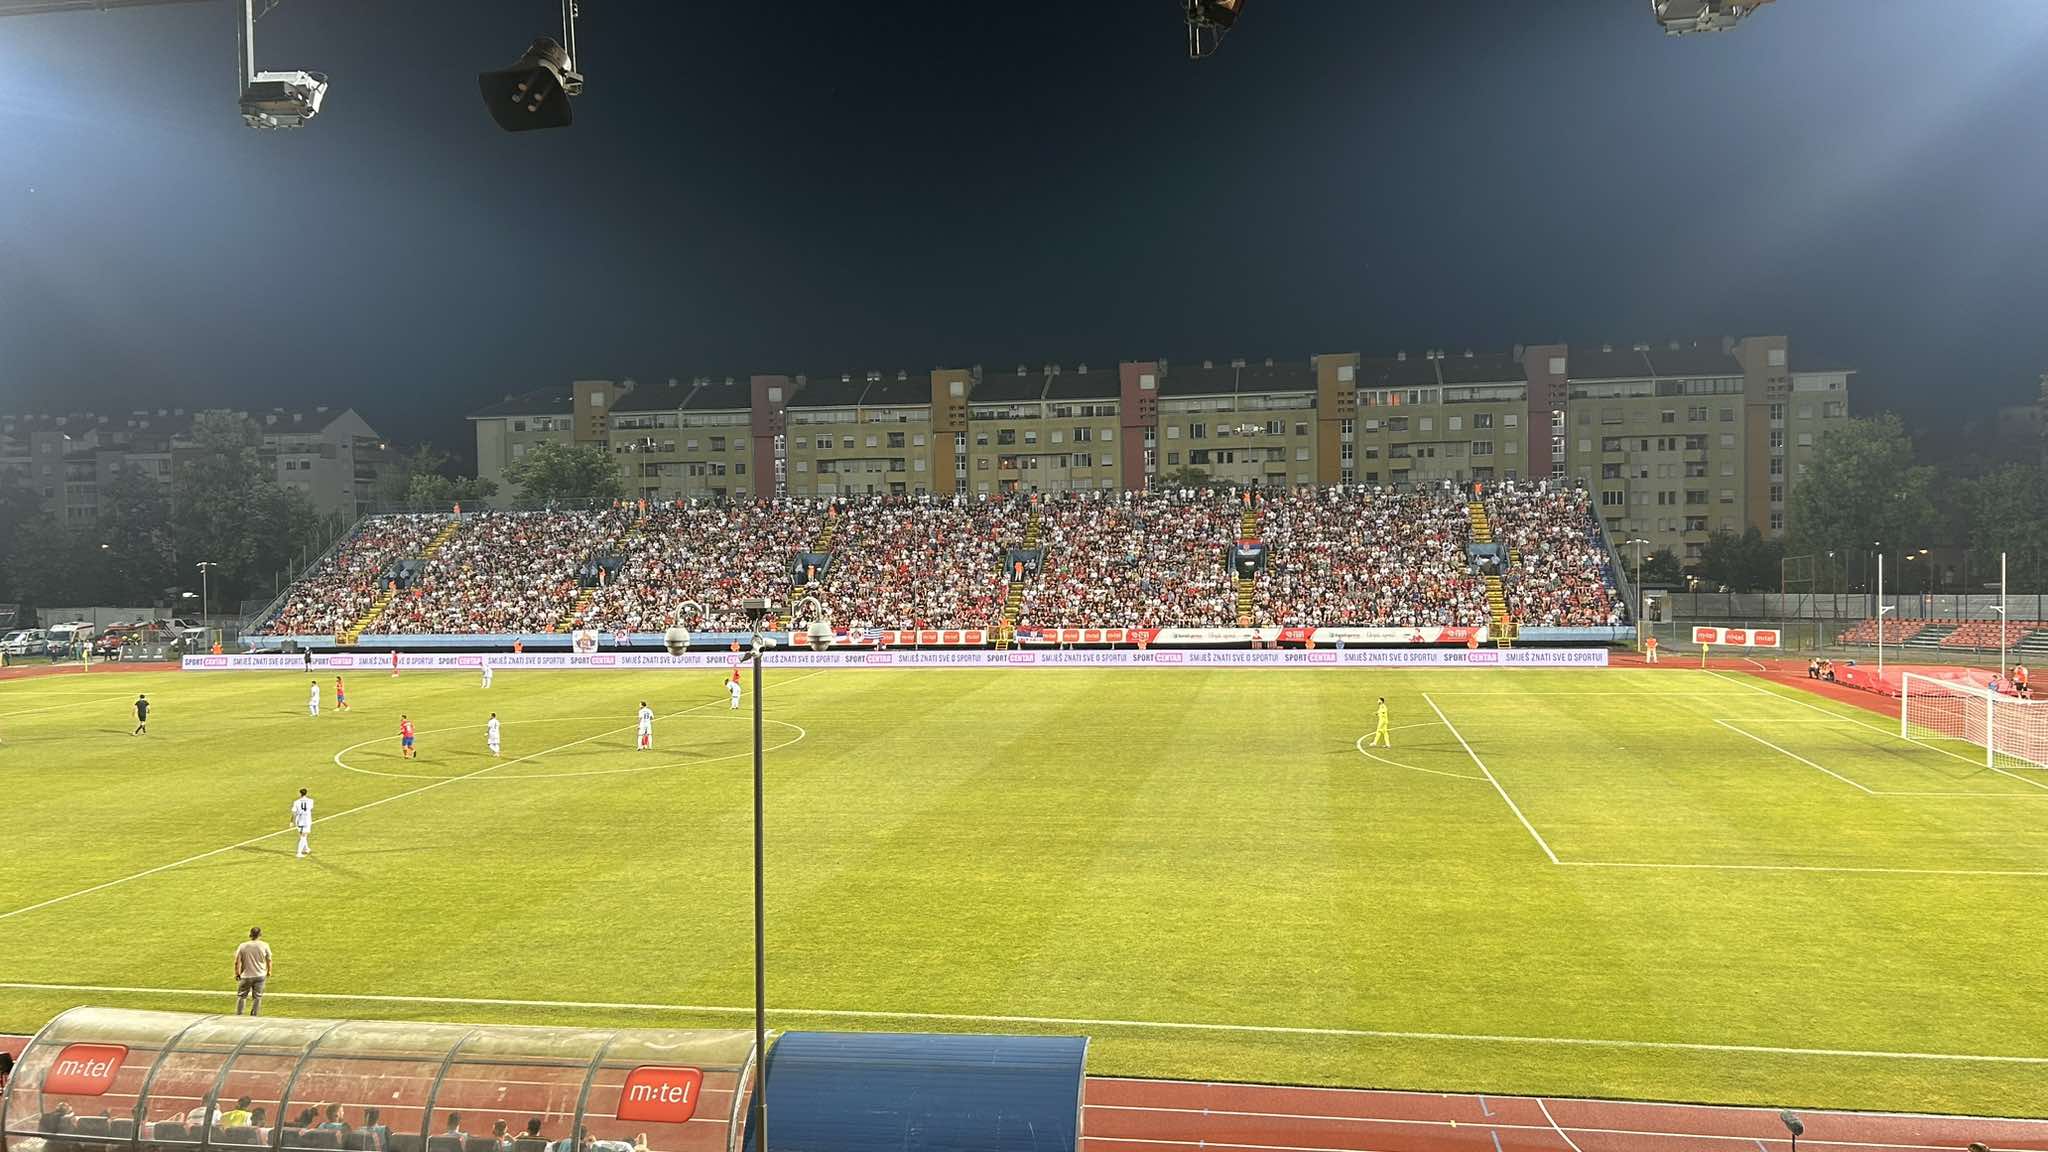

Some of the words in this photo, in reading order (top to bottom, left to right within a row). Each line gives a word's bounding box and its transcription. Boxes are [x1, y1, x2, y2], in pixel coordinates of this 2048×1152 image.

[185, 658, 202, 666] SPORT
[253, 658, 268, 666] ZNATI
[269, 658, 279, 666] SVE
[438, 657, 457, 665] SPORT
[508, 657, 524, 665] ZNATI
[525, 657, 536, 665] SVE
[1133, 654, 1154, 662] SPORT
[1213, 654, 1231, 662] ZNATI
[1232, 654, 1244, 662] SVE
[1285, 654, 1307, 662] SPORT
[1369, 654, 1388, 662] ZNATI
[1389, 654, 1402, 662] SVE
[1444, 654, 1467, 662] SPORT
[1531, 654, 1551, 662] ZNATI
[1552, 654, 1565, 662] SVE
[300, 801, 307, 812] 4
[57, 1057, 116, 1077] m:tel
[629, 1081, 691, 1103] m:tel
